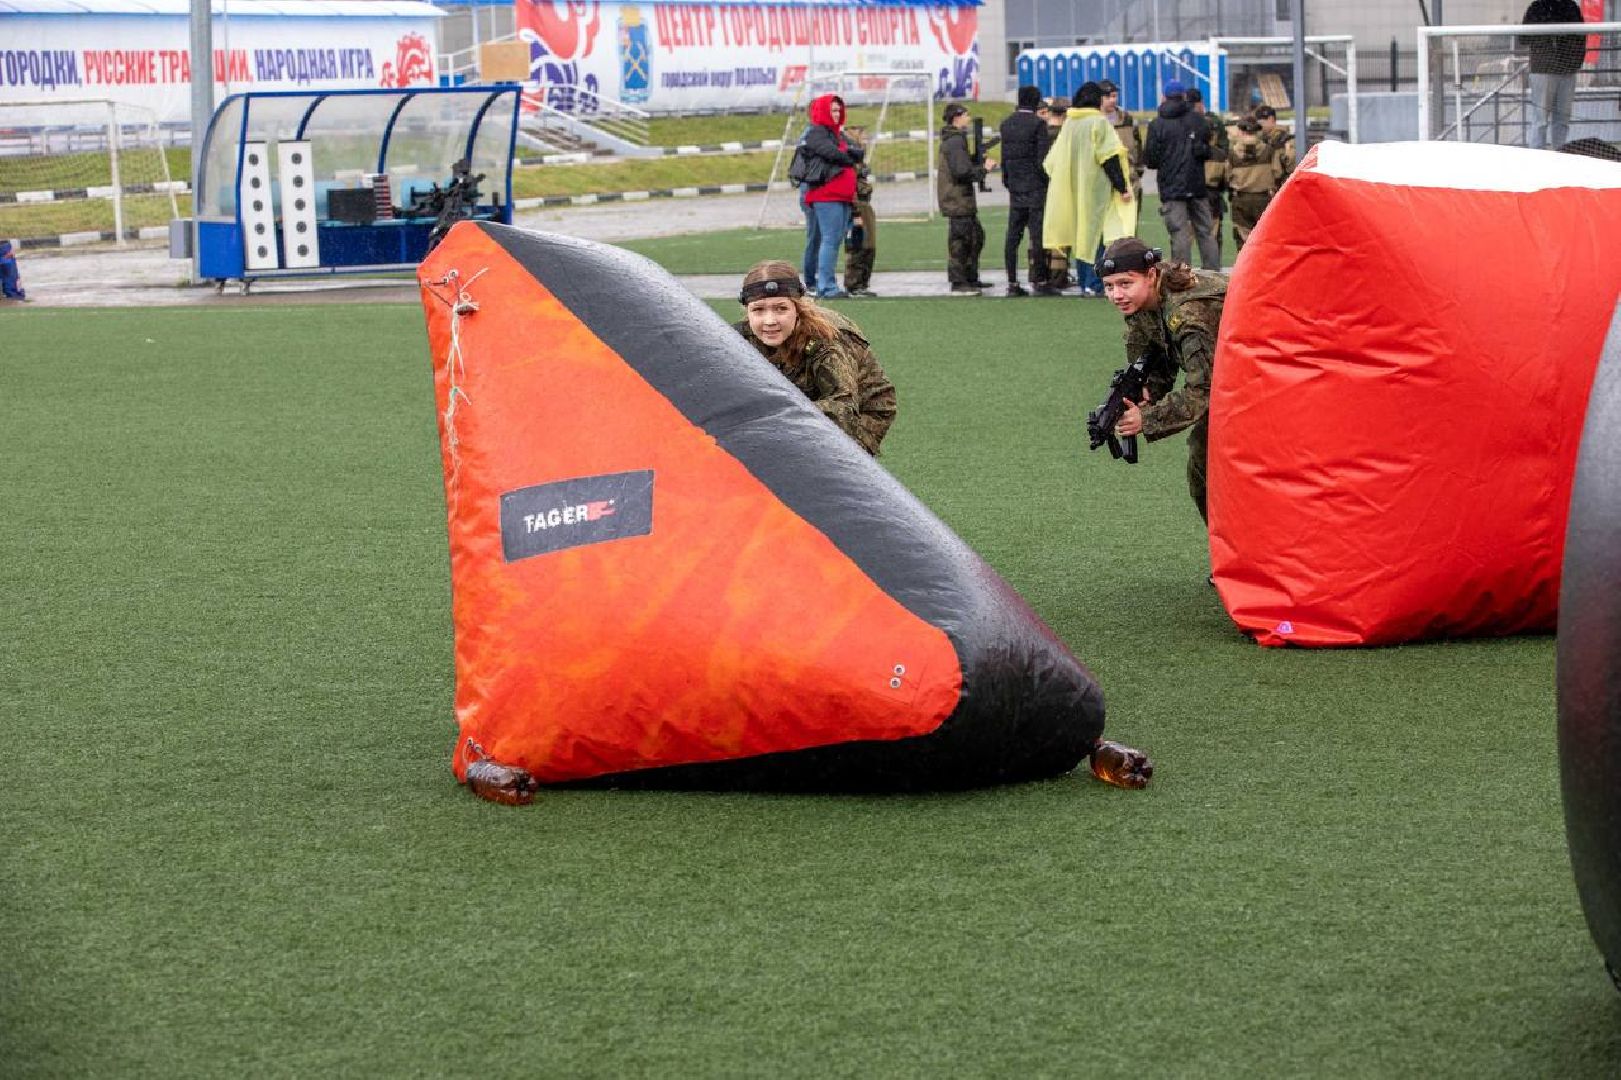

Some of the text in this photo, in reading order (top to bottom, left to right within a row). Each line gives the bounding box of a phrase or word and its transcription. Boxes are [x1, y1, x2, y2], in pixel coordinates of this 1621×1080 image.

[654, 4, 920, 53] ЦЕНТР ГОРОДОШНОГО СПОРТА
[83, 49, 156, 84] РУССКИЕ
[159, 49, 253, 86] ТРАЦИИ,
[254, 48, 338, 86] НАРОДНАЯ
[339, 48, 374, 79] ИГРА
[523, 504, 589, 534] TAGER
